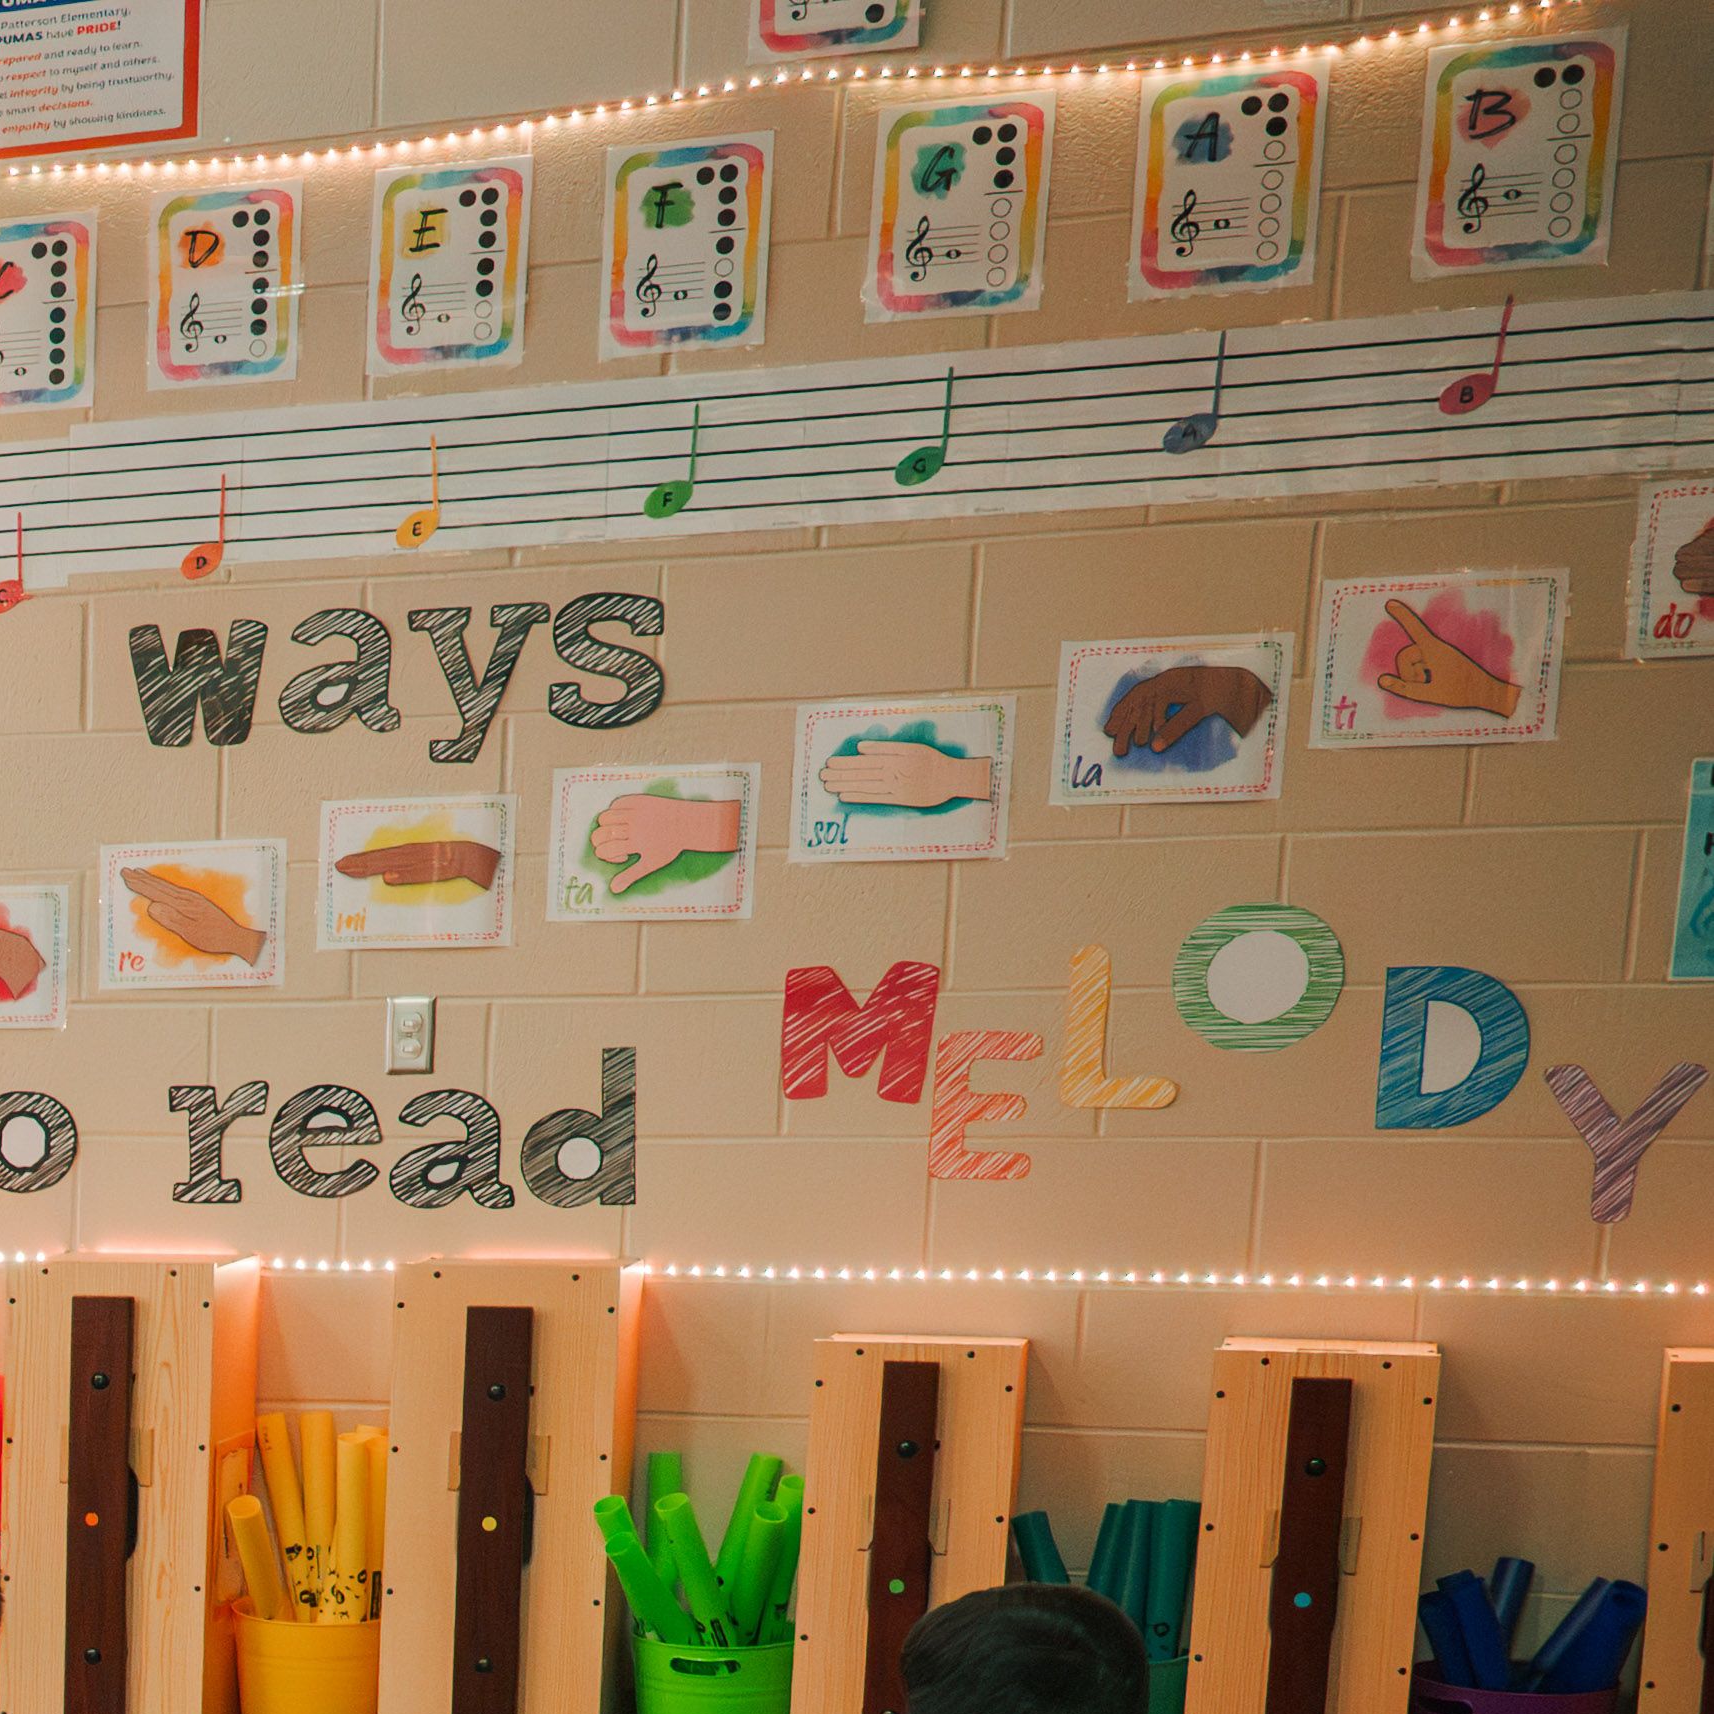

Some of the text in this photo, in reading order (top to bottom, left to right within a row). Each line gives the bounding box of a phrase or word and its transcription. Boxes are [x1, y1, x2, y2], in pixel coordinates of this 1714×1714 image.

[0, 15, 58, 31] Patterson
[46, 28, 75, 40] have
[76, 21, 122, 37] PRIDE!
[5, 69, 47, 83] respect
[49, 67, 61, 77] to
[62, 63, 98, 77] myself
[100, 60, 122, 71] and
[123, 56, 161, 67] others.
[43, 49, 65, 60] and
[66, 45, 98, 58] ready
[99, 43, 111, 53] to
[112, 41, 144, 52] learn.
[9, 85, 59, 100] integrity
[61, 83, 75, 95] by
[76, 79, 106, 93] being
[108, 71, 175, 87] trustworthy.
[2, 120, 52, 137] empathy
[53, 118, 67, 130] by
[68, 113, 115, 126] showing
[116, 107, 167, 121] kindness.
[5, 105, 36, 117] smart
[38, 99, 94, 113] decisions.
[1460, 91, 1519, 135] B
[1184, 111, 1223, 163] A
[920, 146, 956, 192] G
[650, 181, 684, 230] F
[186, 229, 221, 268] D
[412, 208, 449, 253] E
[1459, 386, 1475, 403] B
[661, 491, 674, 507] F
[411, 521, 424, 537] E
[195, 555, 209, 570] D
[1652, 601, 1696, 641] do
[128, 592, 668, 765] ways
[1333, 693, 1360, 731] ti
[1071, 752, 1104, 790] la
[806, 810, 851, 850] sol
[562, 873, 596, 911] fa
[334, 907, 367, 934] mi
[116, 949, 147, 976] re
[781, 900, 1710, 1225] MELODY
[168, 1046, 639, 1209] read
